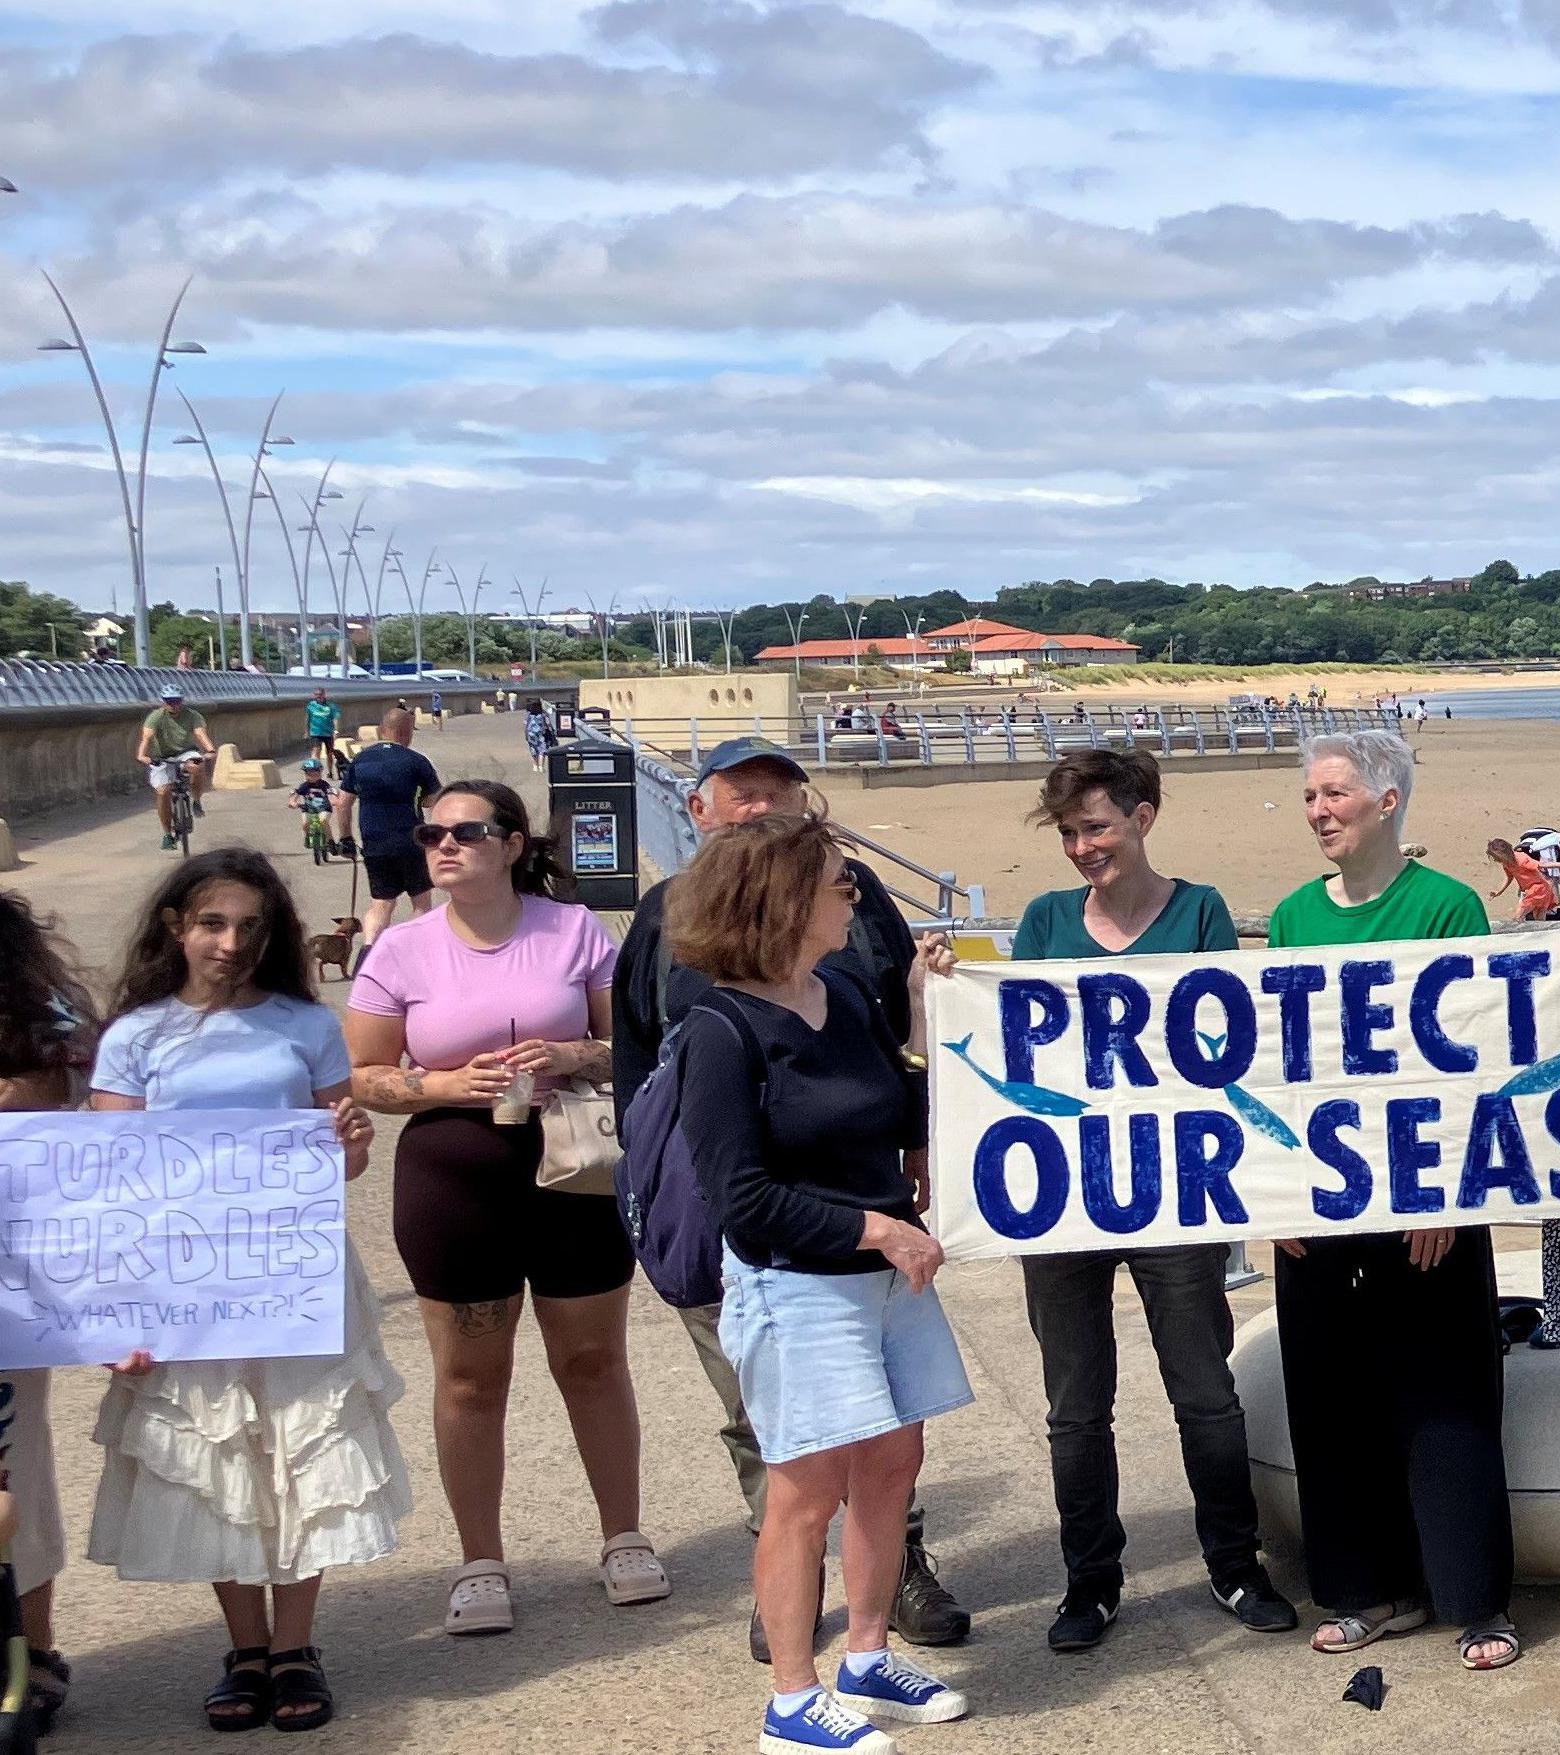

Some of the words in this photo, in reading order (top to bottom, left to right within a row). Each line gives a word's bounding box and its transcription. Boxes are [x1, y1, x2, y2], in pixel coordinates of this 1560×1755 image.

[575, 801, 612, 810] LITTER
[999, 950, 1552, 1089] PROTECT
[973, 1110, 1249, 1240] OUR
[53, 1300, 200, 1331] WHATEVER
